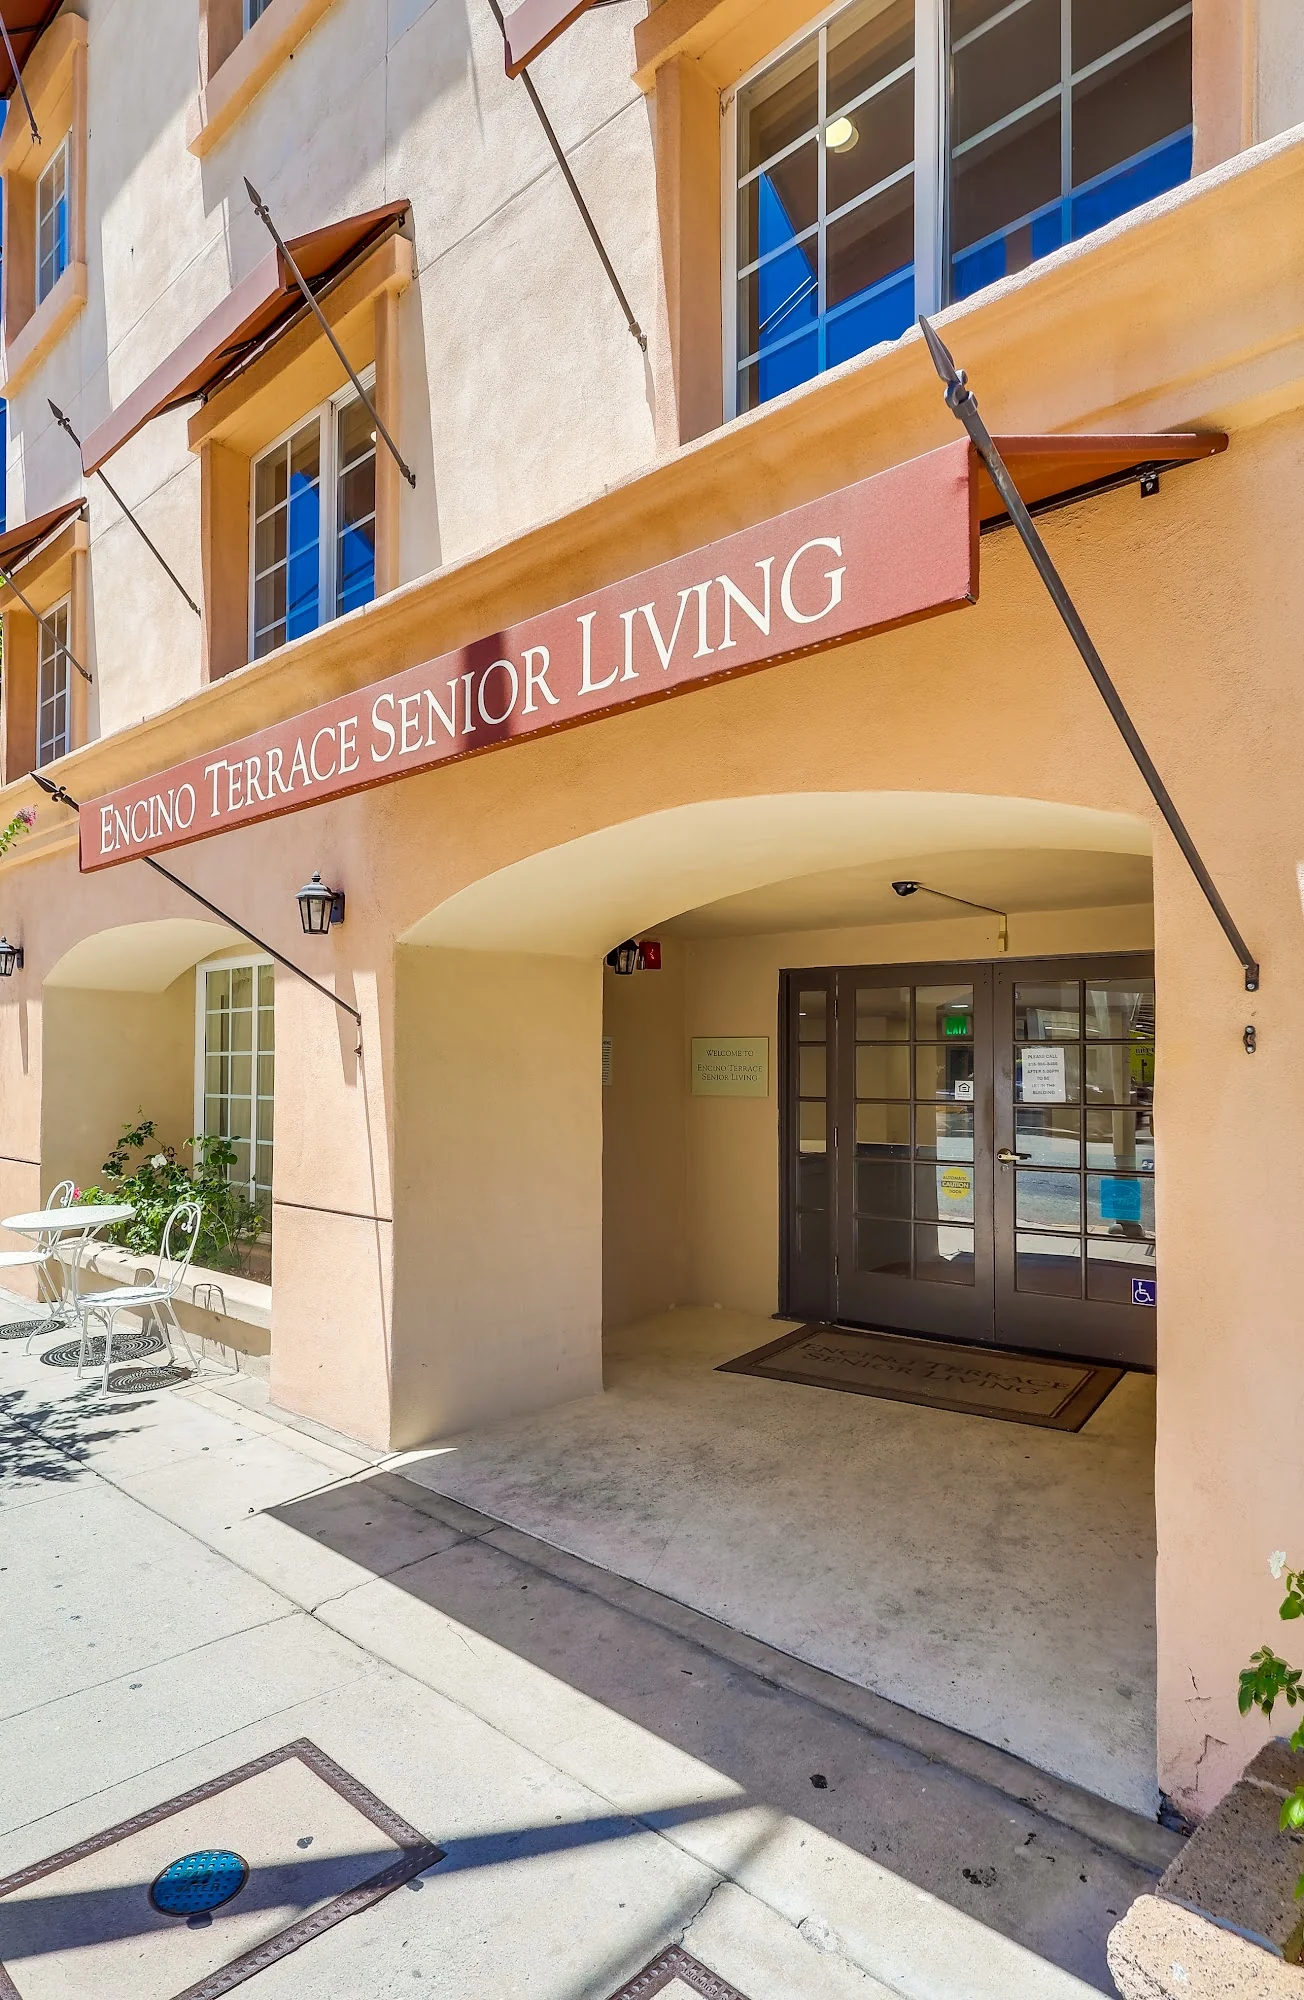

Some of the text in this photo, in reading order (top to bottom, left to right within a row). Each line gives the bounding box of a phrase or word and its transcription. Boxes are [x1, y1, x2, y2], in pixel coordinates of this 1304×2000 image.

[100, 535, 847, 855] ENCINO TERRACE SENIOR LIVING
[706, 1049, 742, 1057] WELCOME
[697, 1063, 763, 1072] ENCINO TERRACE
[701, 1073, 758, 1082] SENIOR LIVING
[942, 1181, 969, 1189] CAUTION
[798, 1342, 1070, 1391] ENCINO TERRACE
[802, 1351, 1042, 1396] SENIOR LIVING
